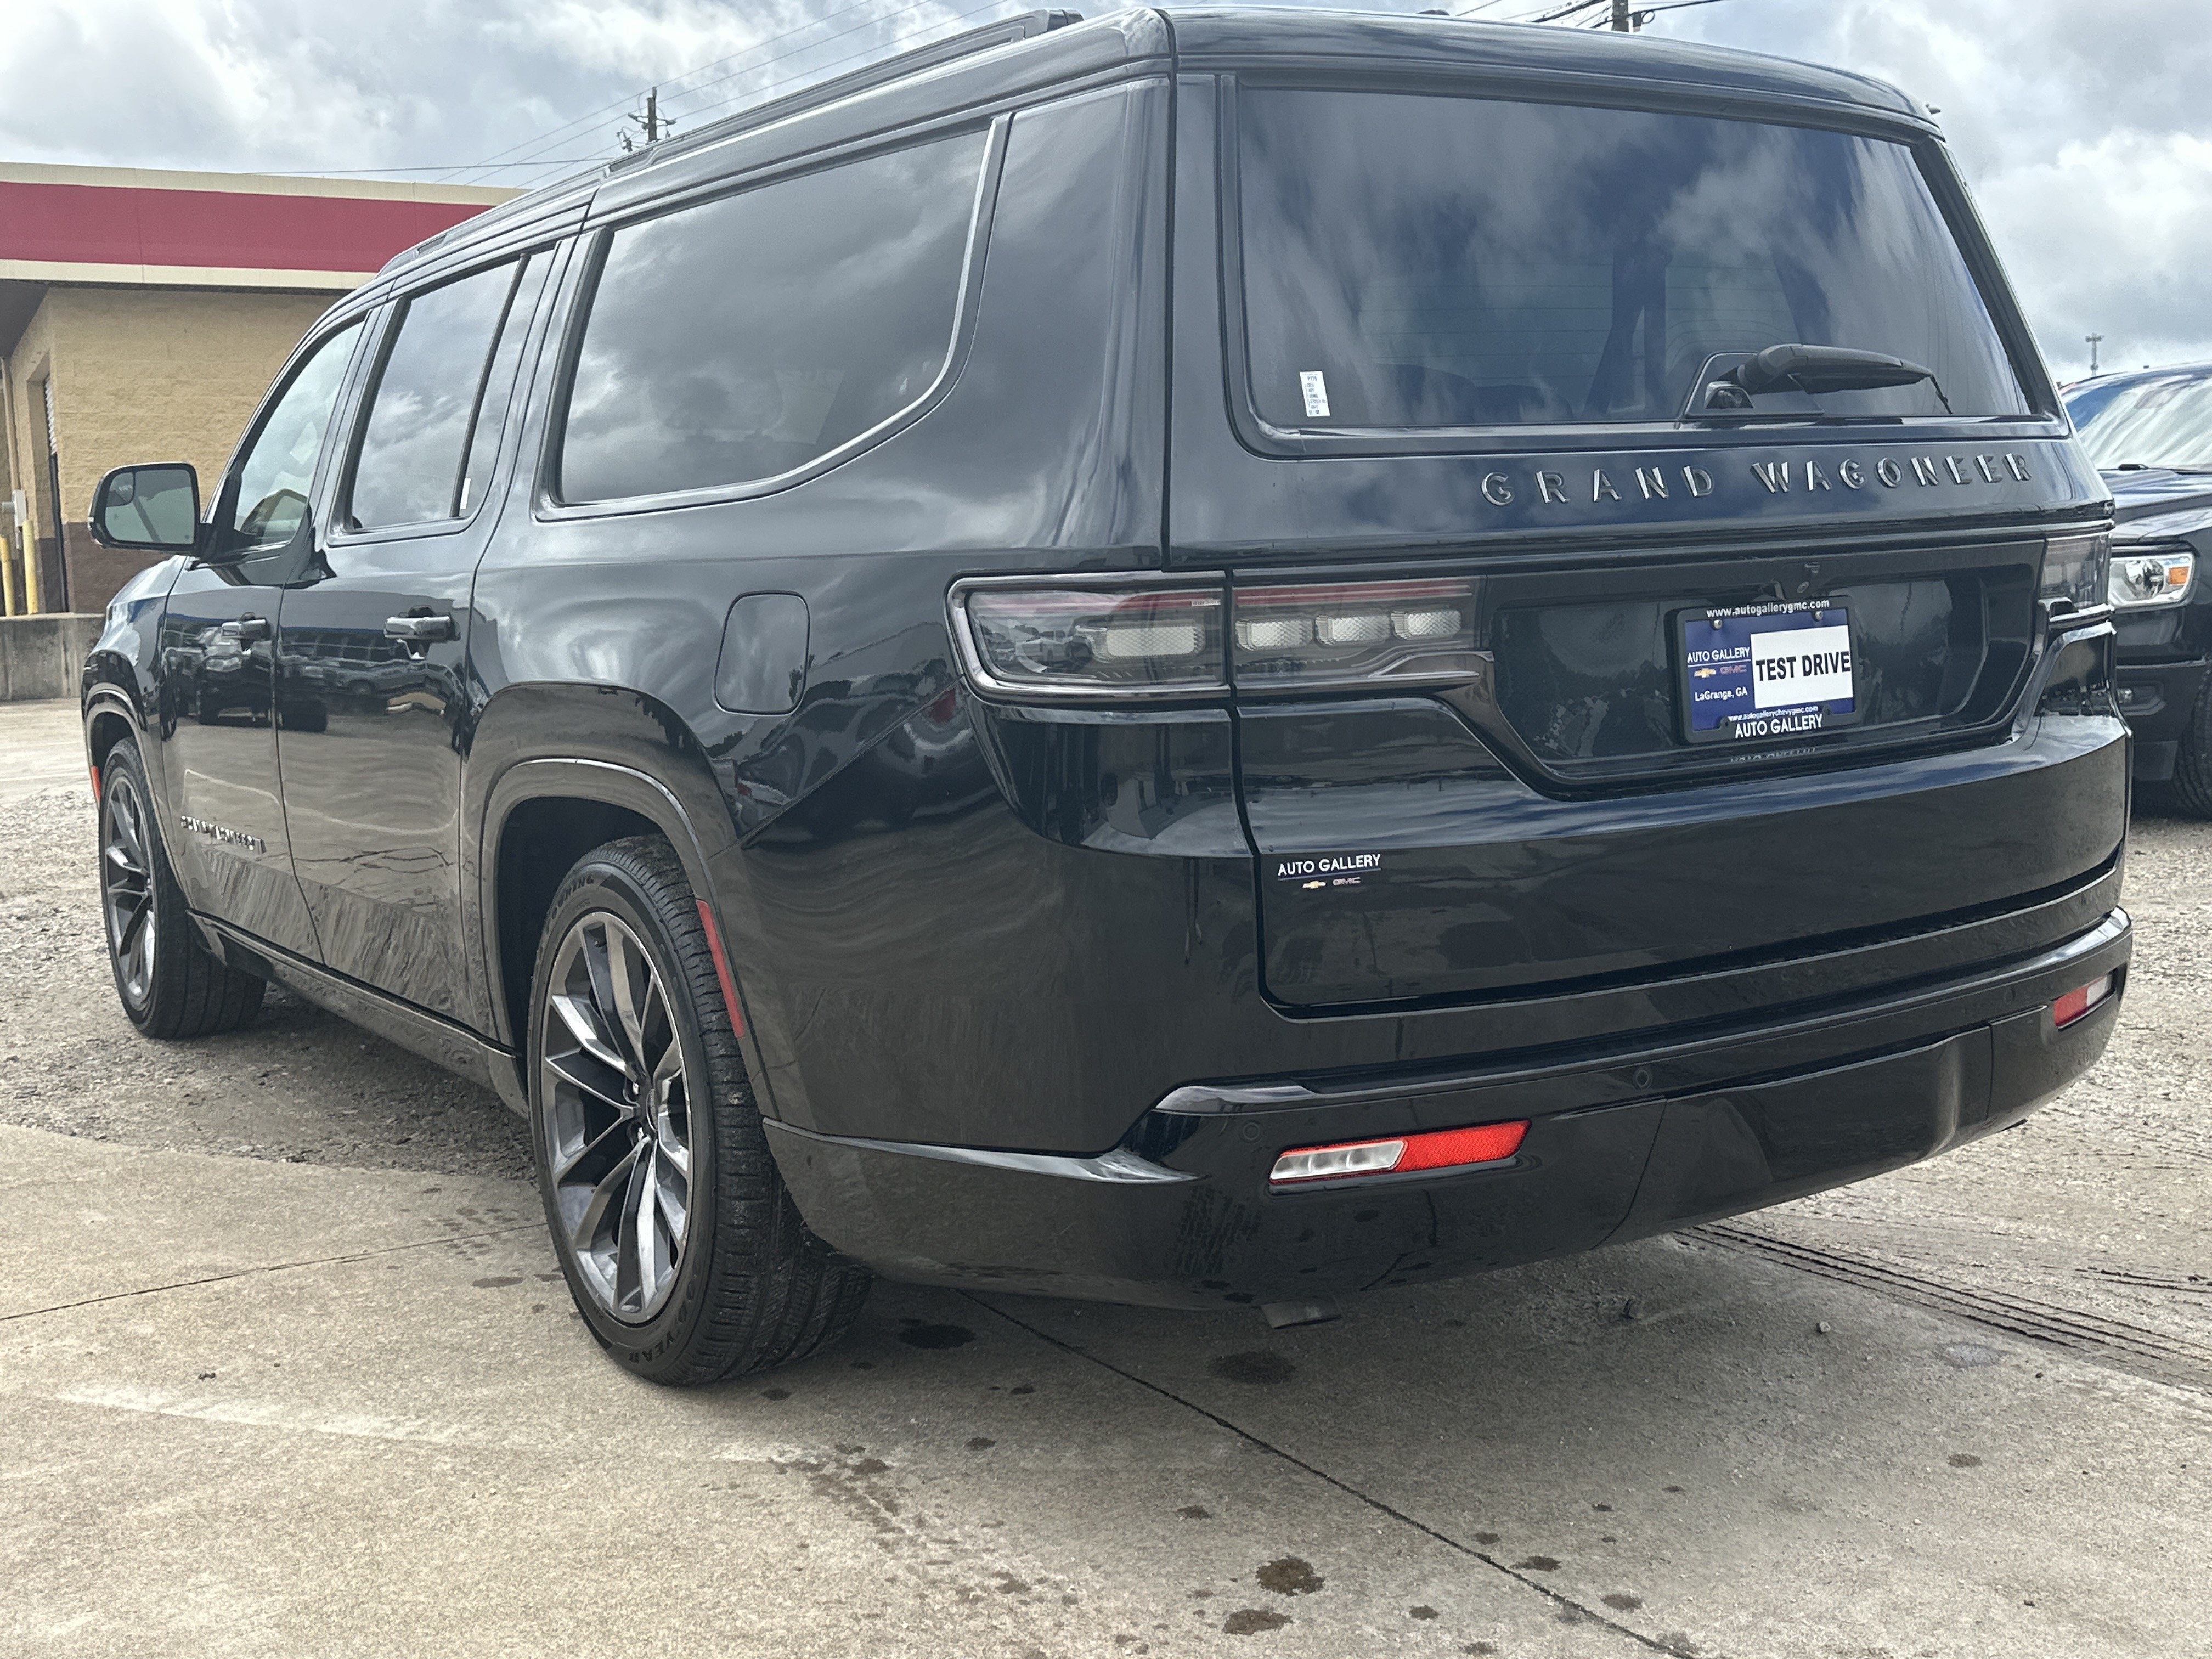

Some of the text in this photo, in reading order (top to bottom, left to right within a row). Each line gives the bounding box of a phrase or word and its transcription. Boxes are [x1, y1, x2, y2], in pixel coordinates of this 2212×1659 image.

[1481, 452, 2032, 506] GRAND WAGONEER
[1706, 600, 1830, 618] www.autogallerygmc.com
[1687, 646, 1751, 663] AUTO GALLERY
[1719, 665, 1747, 675] GMC
[1756, 651, 1850, 681] TEST DRIVE
[1695, 686, 1748, 701] LaGrange, GA
[1735, 713, 1823, 738] AUTO GALLERY
[1278, 853, 1381, 876] AUTO GALLERY
